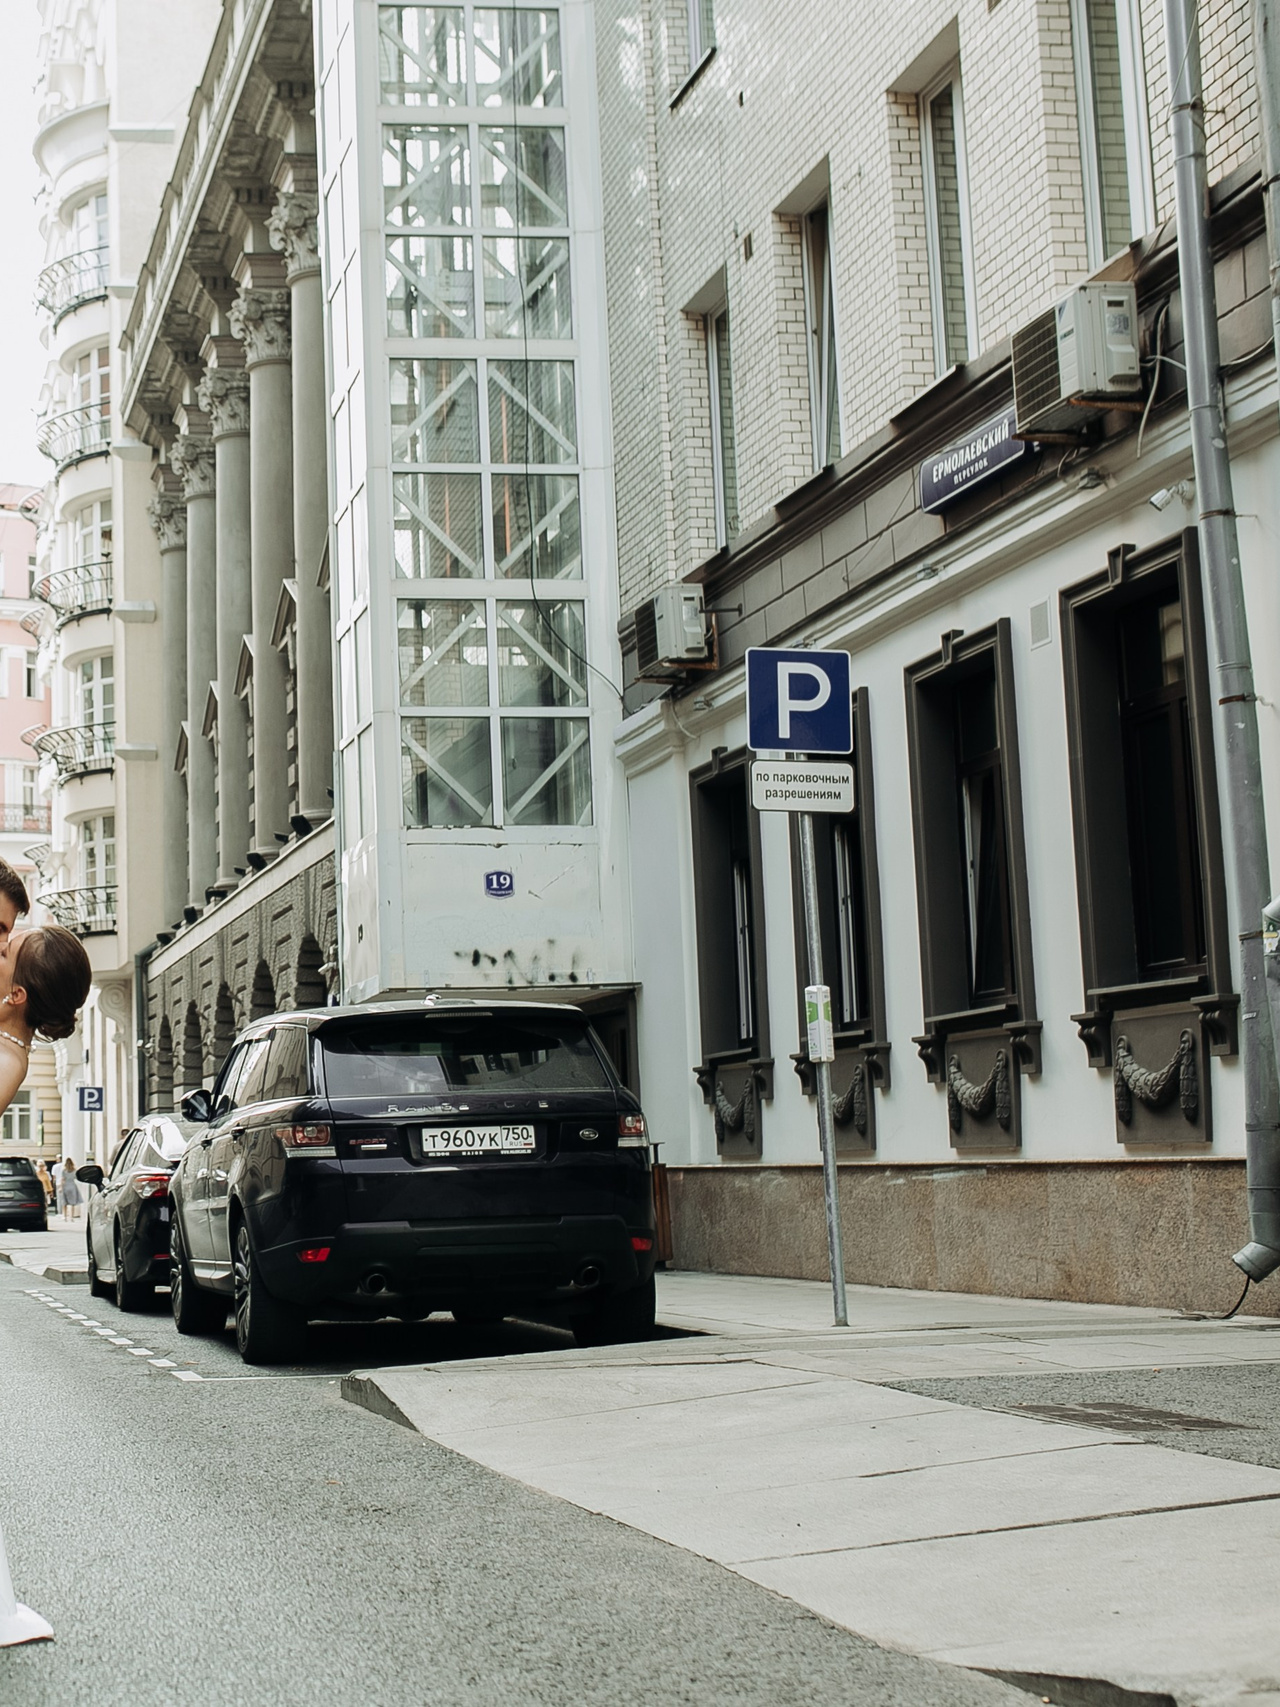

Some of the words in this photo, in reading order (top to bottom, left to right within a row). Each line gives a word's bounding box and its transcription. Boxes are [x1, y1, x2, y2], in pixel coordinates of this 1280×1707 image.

[933, 418, 1009, 483] ЕРМОЛАЕВСКИЙ
[953, 457, 988, 485] ПЕРЕУЛОК
[777, 661, 831, 739] P
[756, 772, 770, 782] по
[773, 772, 850, 785] парковочным
[765, 788, 842, 801] разрешениям
[489, 874, 510, 888] 19
[84, 1088, 99, 1109] P
[502, 1126, 529, 1141] 750
